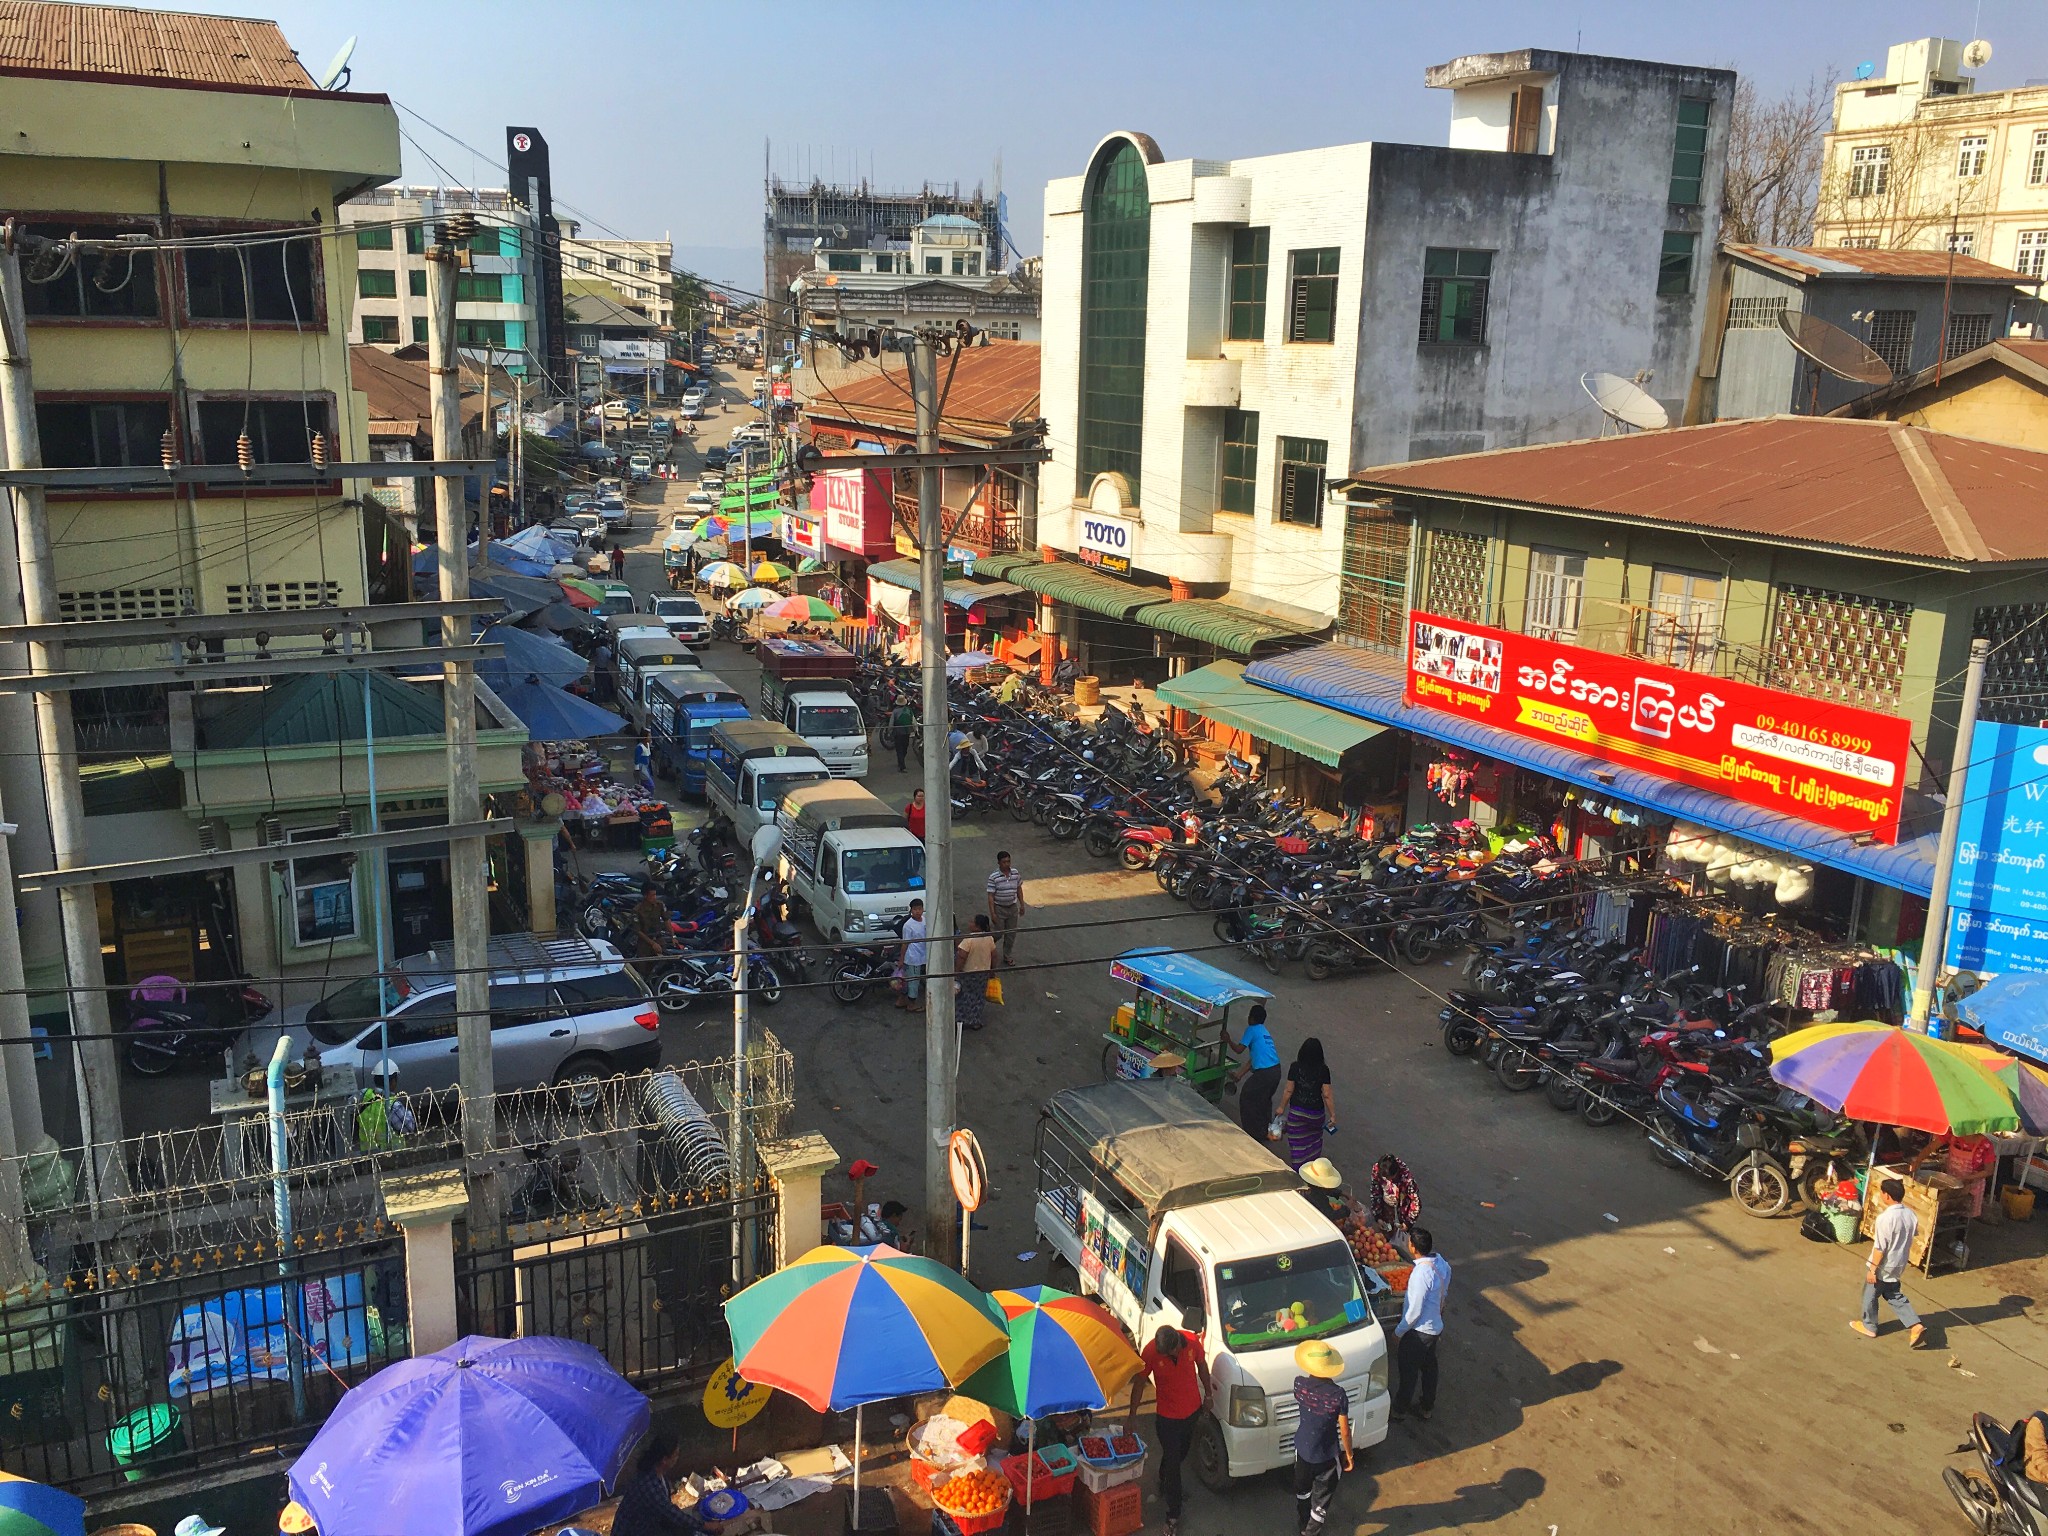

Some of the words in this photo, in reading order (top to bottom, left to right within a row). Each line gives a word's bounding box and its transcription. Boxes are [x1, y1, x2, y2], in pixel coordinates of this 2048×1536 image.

[829, 478, 860, 514] KENT
[838, 514, 860, 529] STORE
[1084, 520, 1126, 548] TOTO
[1517, 658, 1725, 739] အင်အားကြယ်
[1531, 708, 1589, 736] အထည်ဆိုင်
[1831, 732, 1872, 754] 8999
[2024, 782, 2048, 804] W
[2002, 814, 2048, 838] 光纤
[1958, 841, 1988, 865] မြန်မာ
[1991, 848, 2046, 874] အင်တာနက်
[1958, 878, 1986, 889] Lashio
[1987, 882, 2011, 893] Office
[1956, 890, 1985, 901] Hotline
[2020, 901, 2048, 912] 09-400-
[1957, 912, 1982, 932] မြန်မာ
[1984, 917, 2030, 941] အင်တာနက်
[1981, 947, 2002, 956] Office
[524, 1478, 537, 1488] XIN
